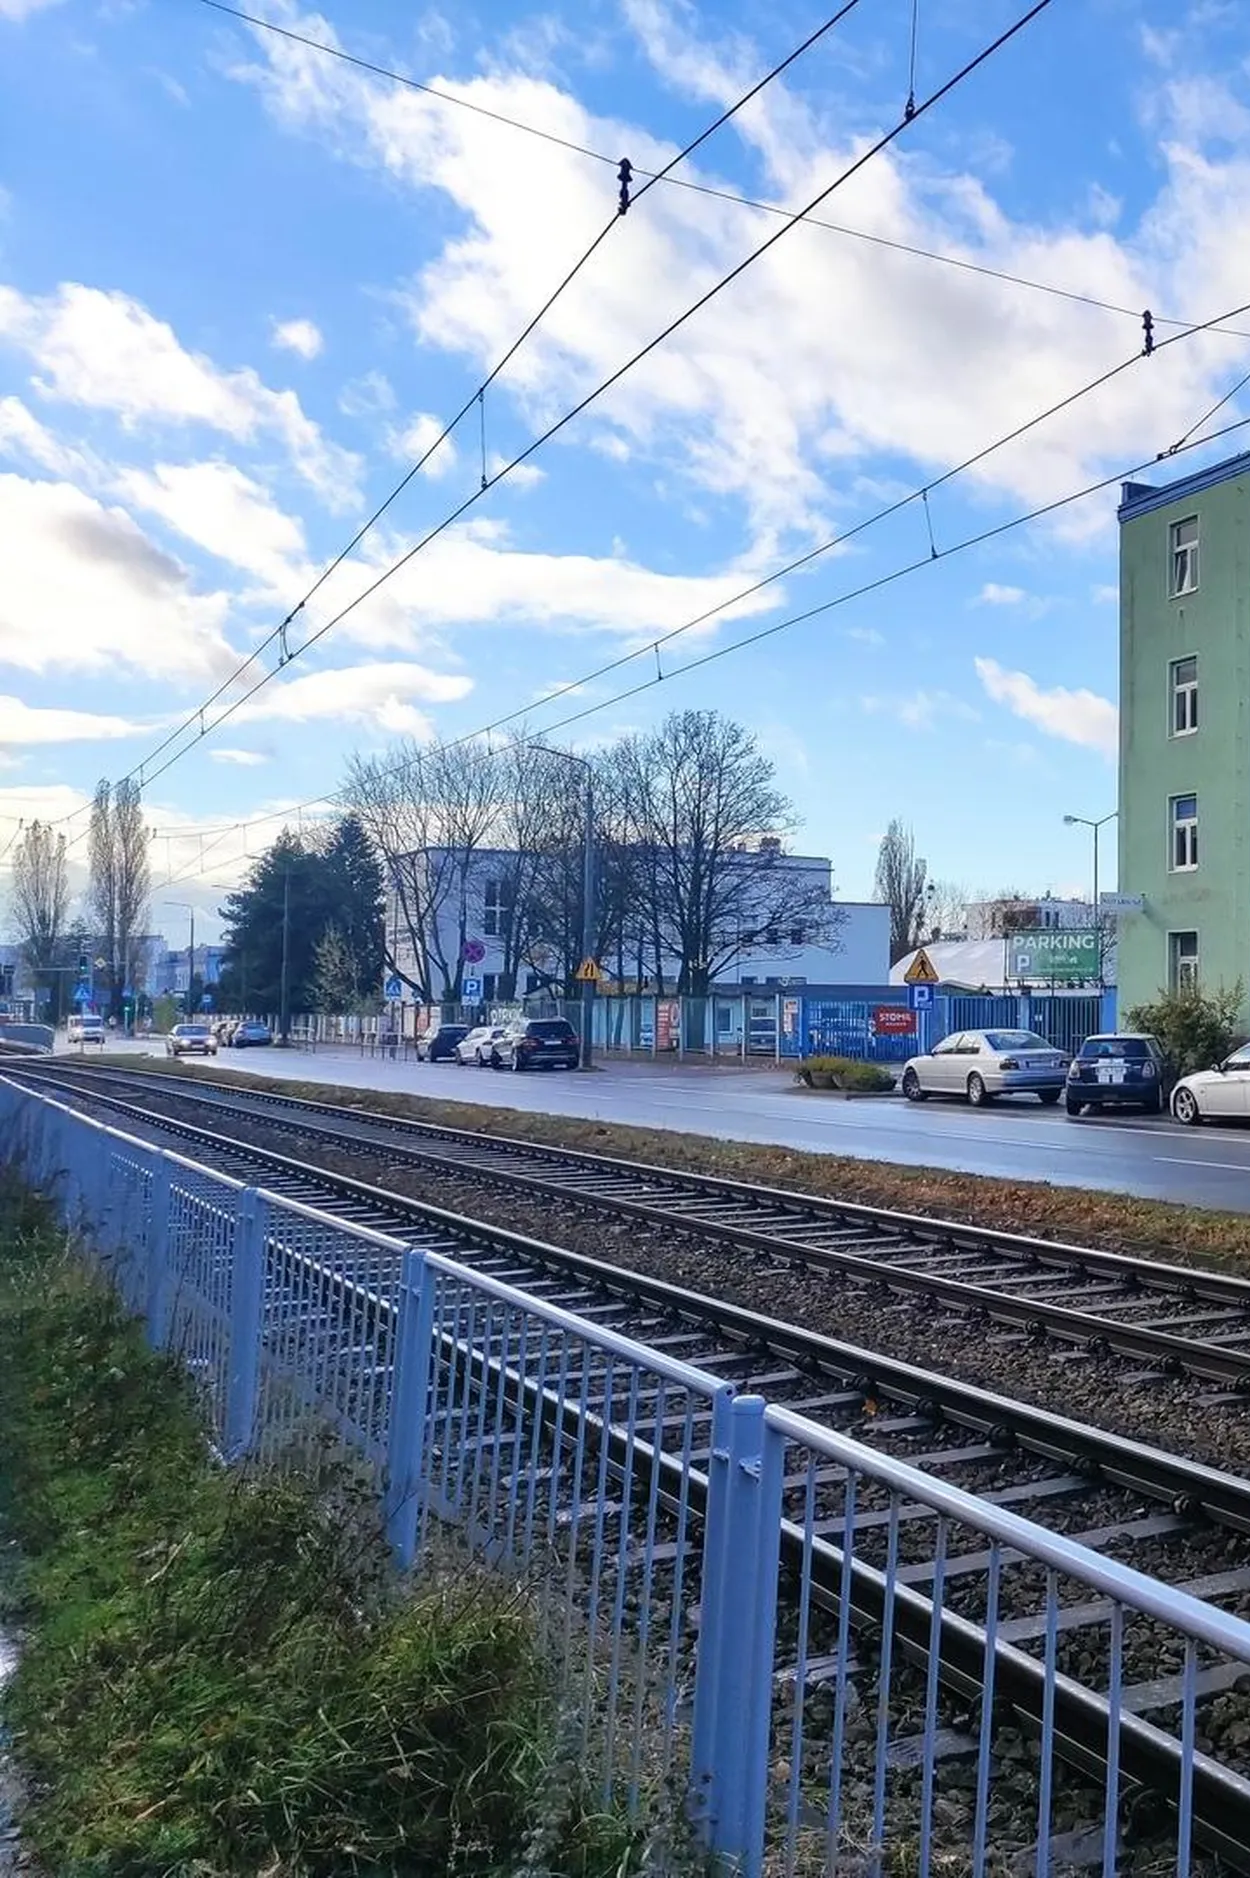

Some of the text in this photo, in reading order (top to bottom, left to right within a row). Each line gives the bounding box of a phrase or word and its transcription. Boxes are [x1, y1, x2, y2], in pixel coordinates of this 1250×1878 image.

[1012, 934, 1095, 949] PARKING
[1017, 954, 1031, 973] P
[914, 986, 929, 1008] P
